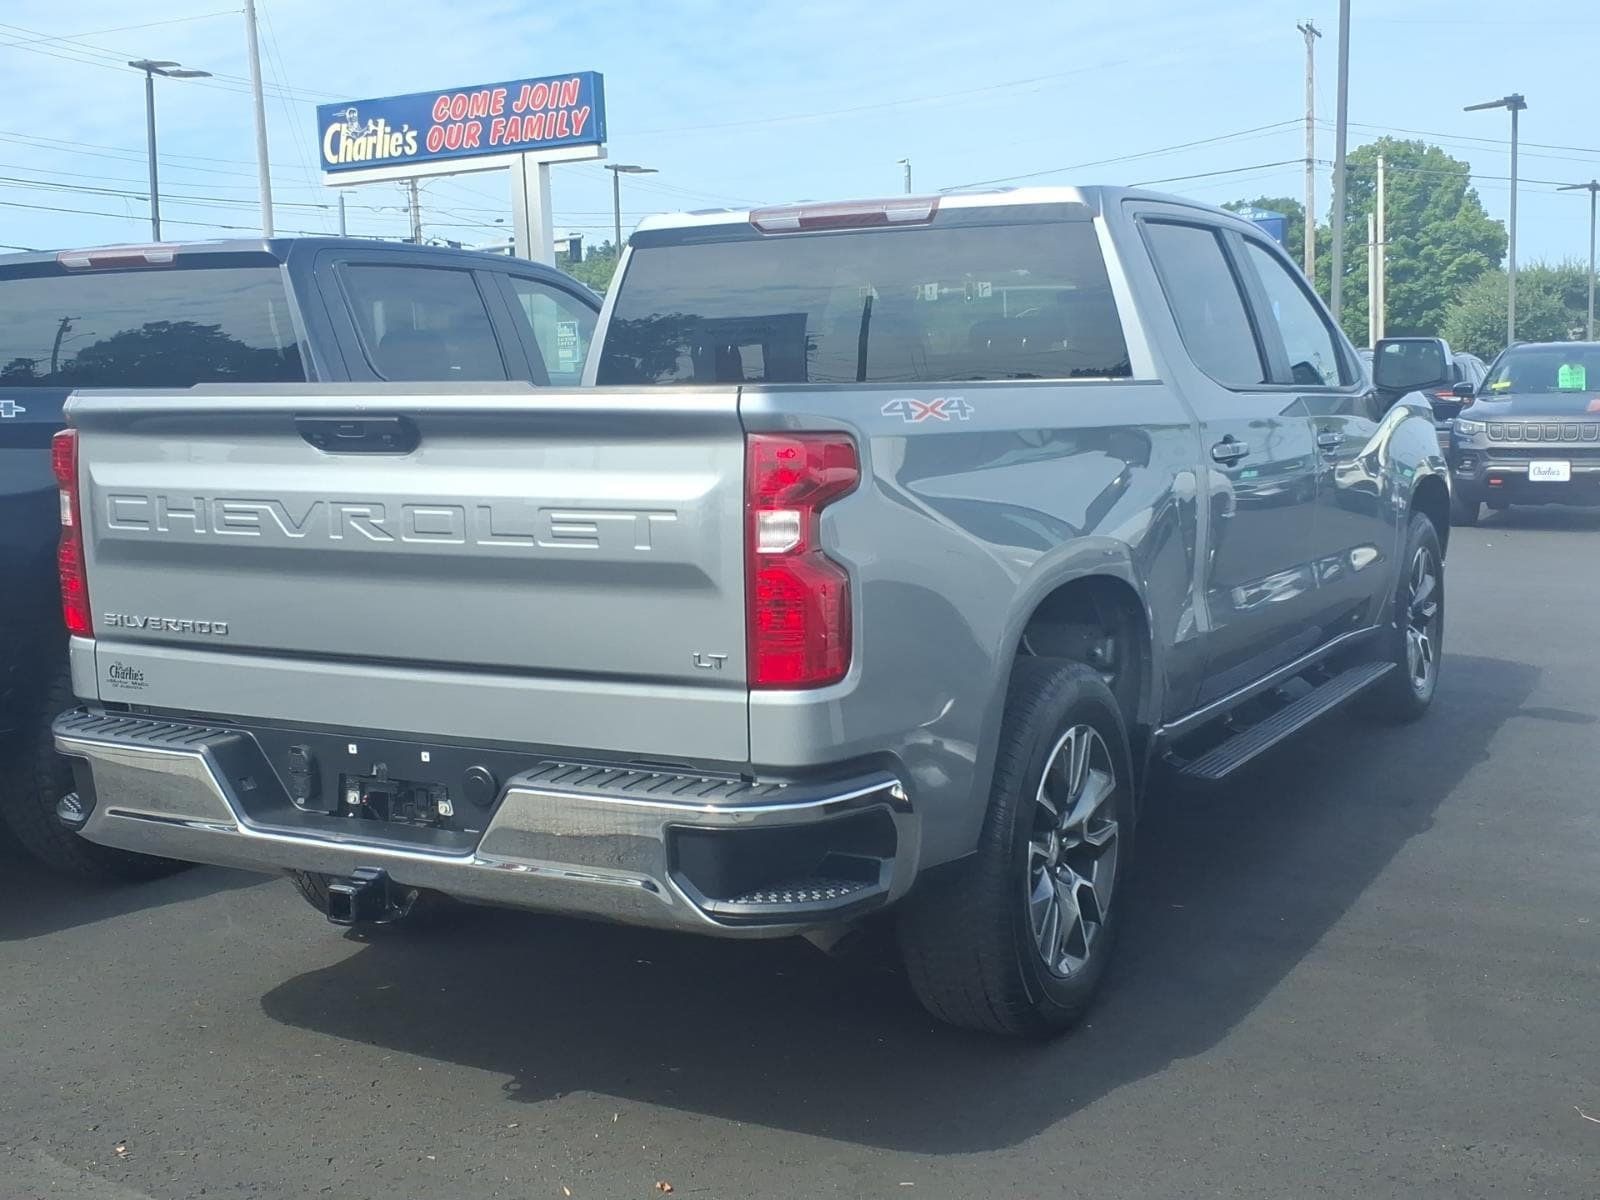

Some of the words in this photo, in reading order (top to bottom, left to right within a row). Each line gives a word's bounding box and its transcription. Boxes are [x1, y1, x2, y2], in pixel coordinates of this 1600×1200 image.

[432, 89, 507, 122] COME
[513, 78, 580, 113] JOIN
[323, 118, 418, 164] Charlie's
[426, 121, 482, 152] OUR
[489, 107, 590, 146] FAMILY
[106, 493, 678, 551] CHEVROLET
[103, 612, 230, 636] SILVERADO
[109, 664, 144, 681] Charlie's
[692, 652, 728, 670] LT
